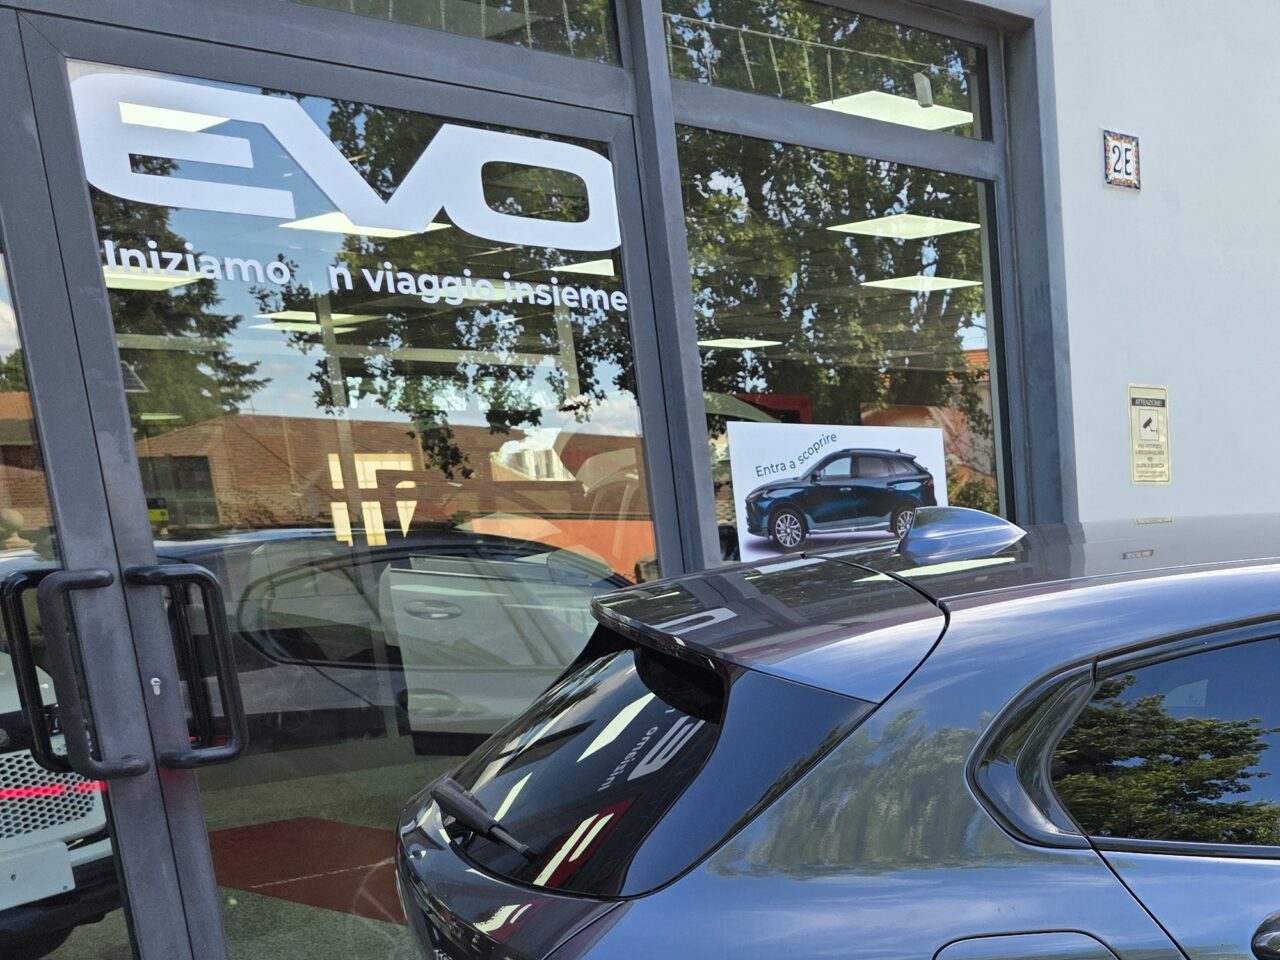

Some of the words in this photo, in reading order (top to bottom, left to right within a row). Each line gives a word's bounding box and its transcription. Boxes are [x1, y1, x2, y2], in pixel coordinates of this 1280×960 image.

[70, 73, 622, 251] EVO
[1112, 144, 1132, 176] 2E
[103, 239, 291, 285] Iniziamo
[361, 261, 494, 306] viaggio
[503, 271, 628, 312] insieme
[755, 462, 787, 477] Entra
[789, 460, 796, 470] a
[797, 433, 838, 465] scoprire
